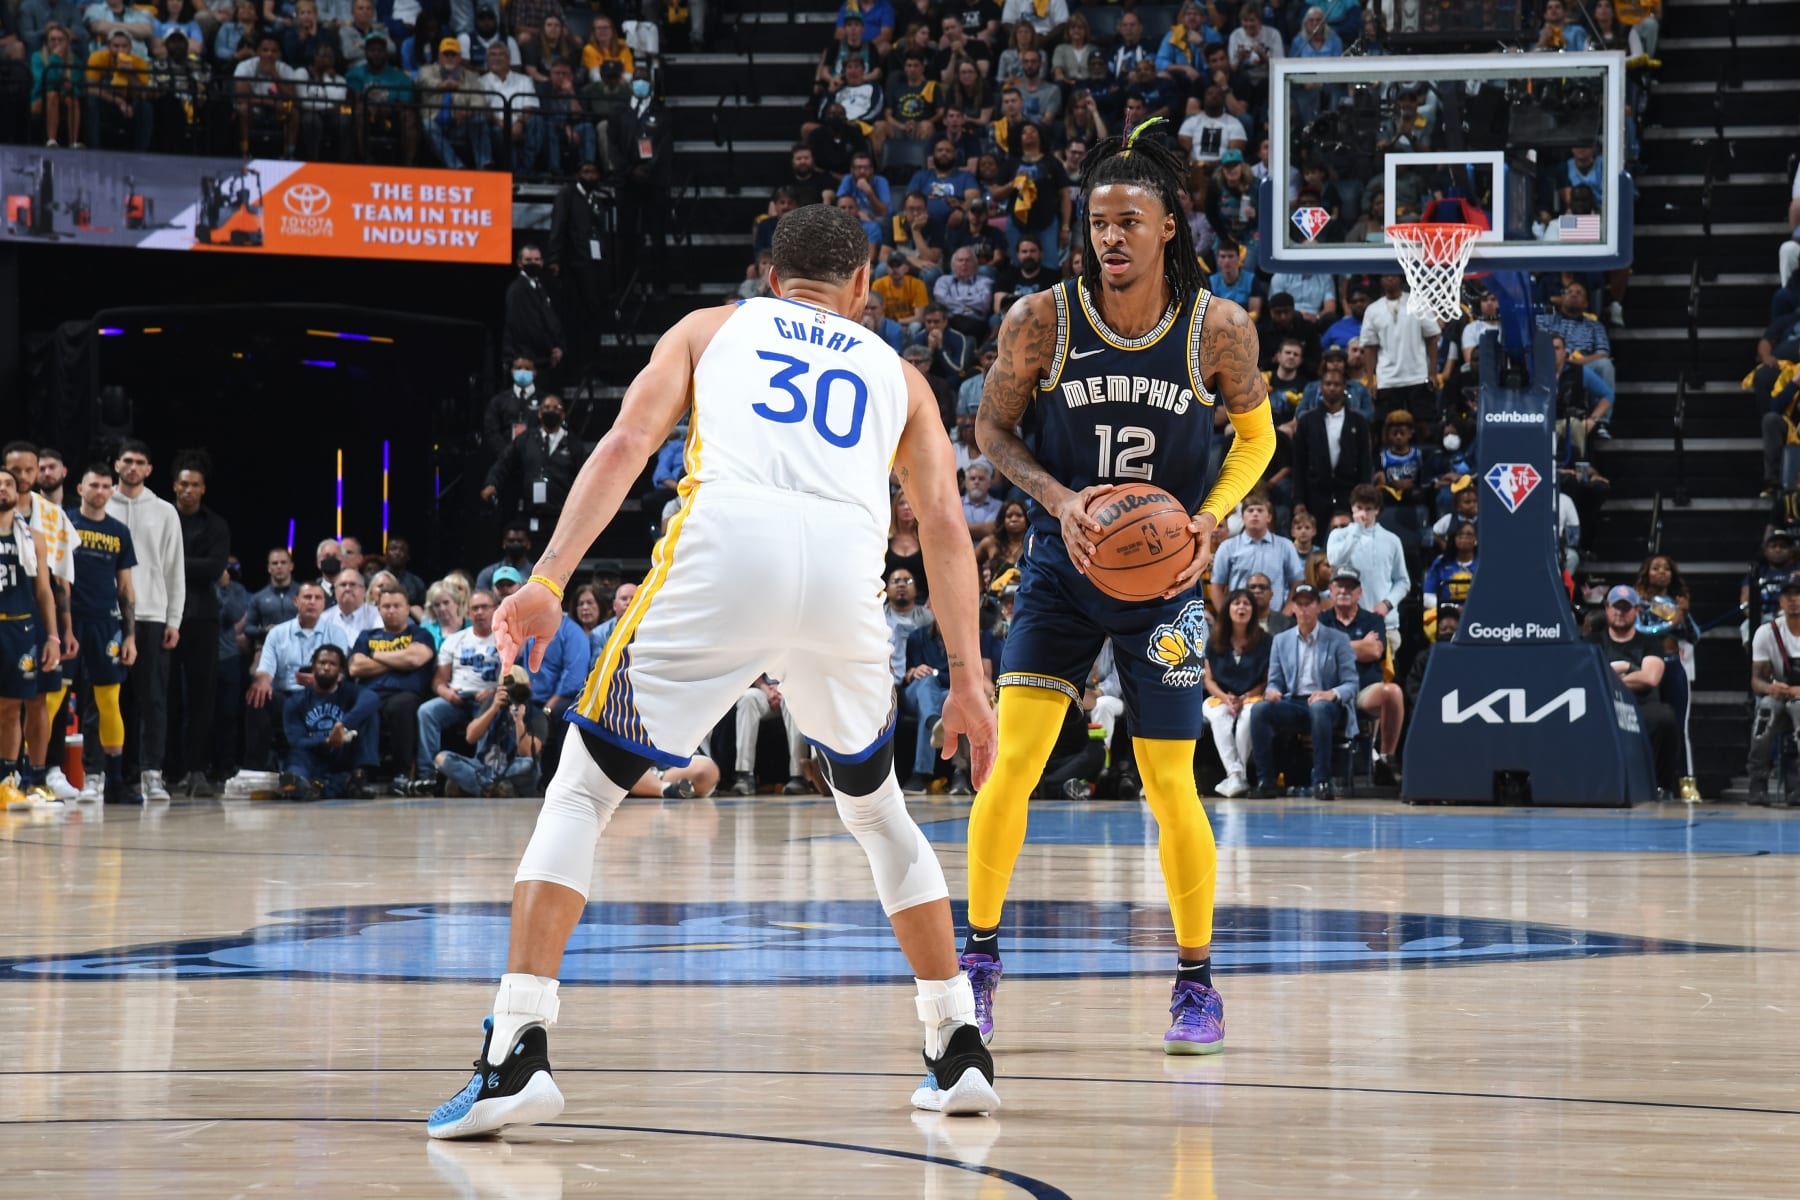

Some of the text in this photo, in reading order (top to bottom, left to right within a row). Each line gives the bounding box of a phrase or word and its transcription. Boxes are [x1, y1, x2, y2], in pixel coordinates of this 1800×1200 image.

[370, 182, 474, 204] THE BEST
[280, 216, 333, 229] TOYOTA
[352, 203, 492, 227] TEAM IN THE
[362, 226, 480, 248] INDUSTRY
[774, 316, 863, 352] CURRY
[752, 350, 868, 448] 30
[1061, 375, 1194, 415] MEMPHIS
[1485, 411, 1544, 423] coinbase
[1095, 425, 1156, 480] 12
[1097, 493, 1173, 527] Wilson
[77, 529, 121, 547] EMPHIS
[1468, 623, 1560, 642] Google Pixel
[1441, 688, 1586, 724] KIA
